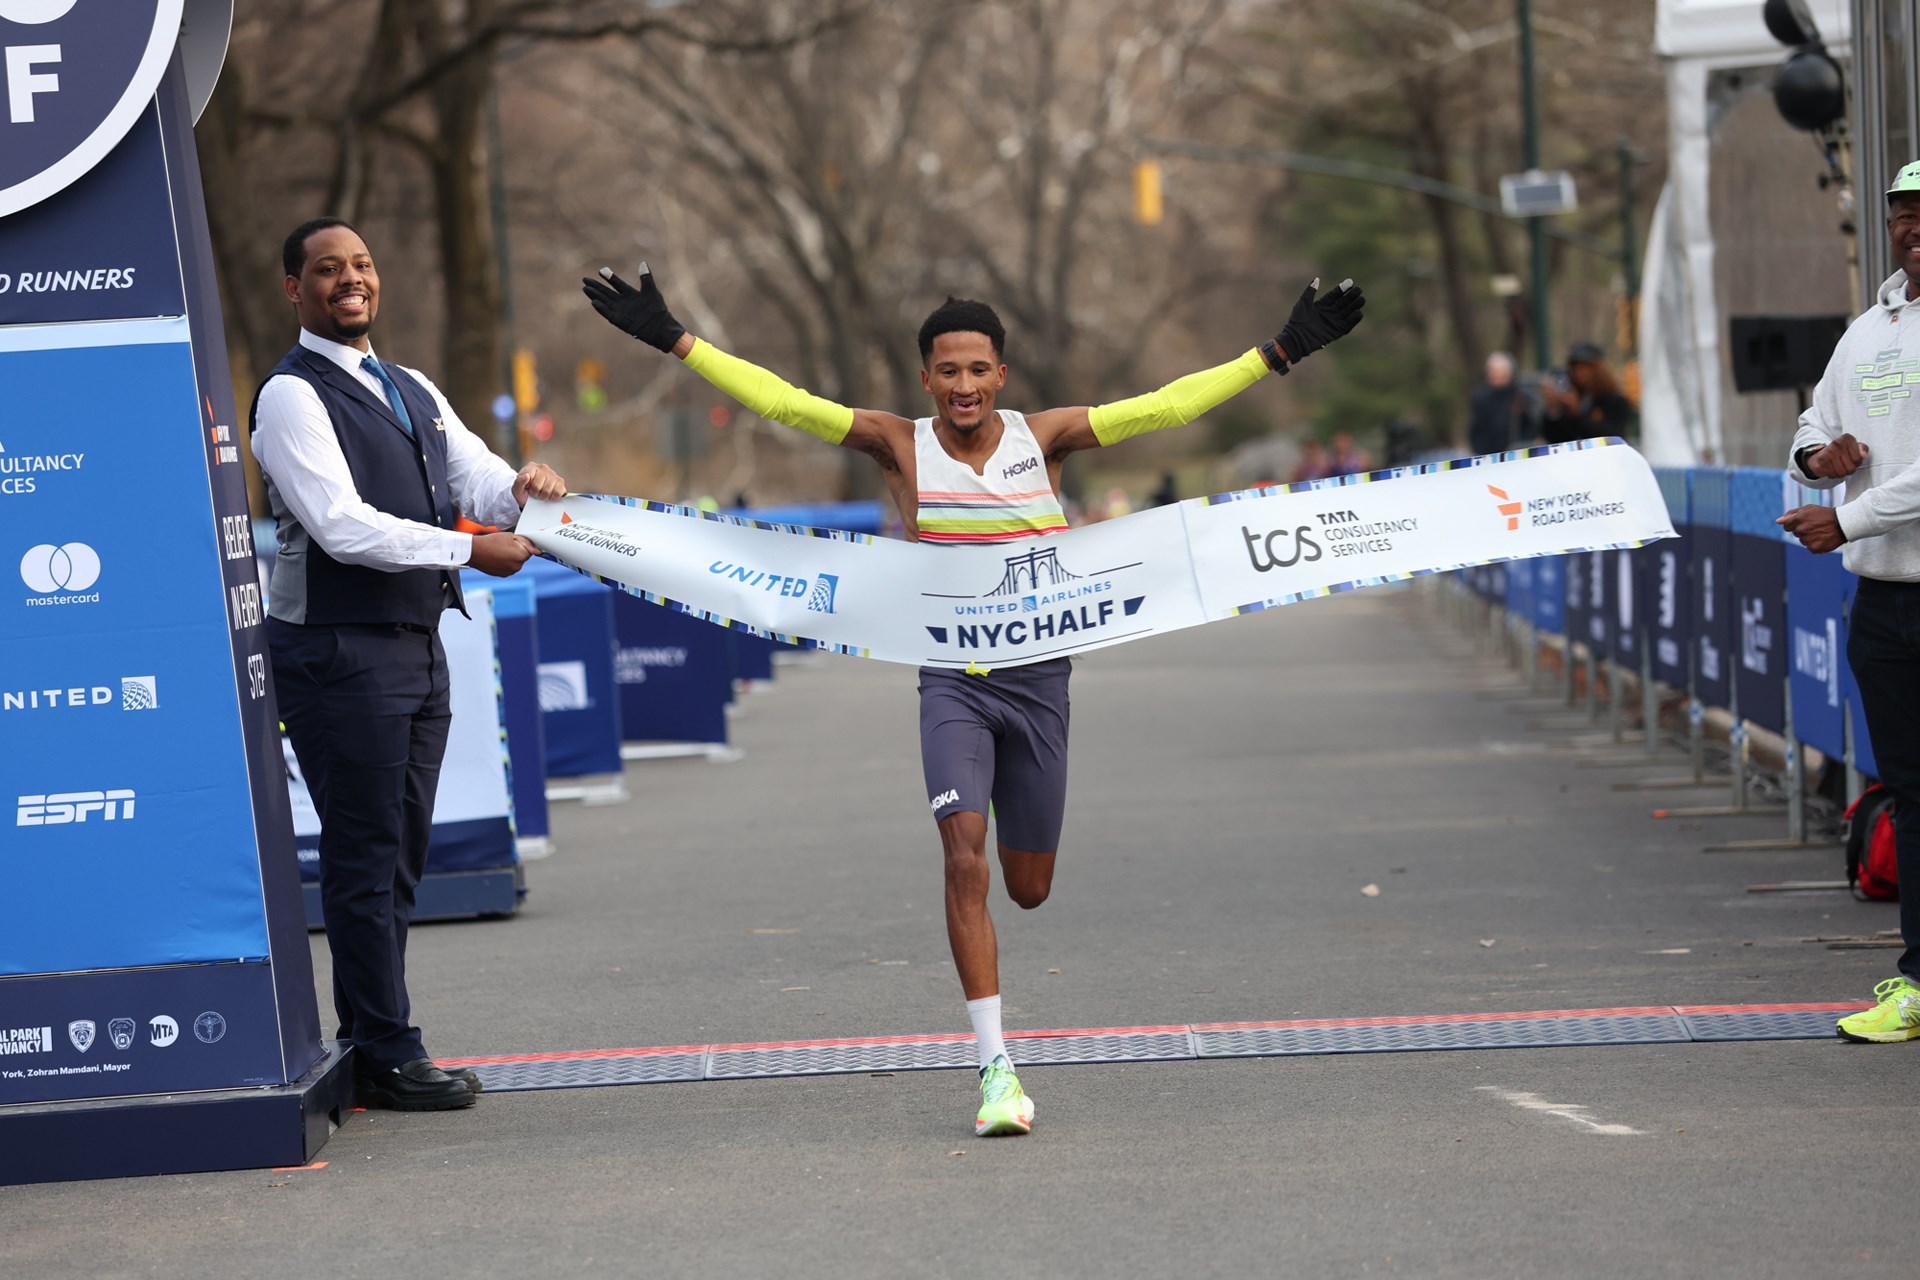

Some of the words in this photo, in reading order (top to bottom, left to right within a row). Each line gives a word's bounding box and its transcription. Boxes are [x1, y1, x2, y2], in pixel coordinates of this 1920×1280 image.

[17, 268, 135, 293] RUNNERS
[1002, 456, 1039, 479] HOKA
[1528, 498, 1555, 512] NEW
[1556, 491, 1592, 507] YORK
[1316, 510, 1359, 525] TATA
[1532, 512, 1566, 527] ROAD
[1569, 502, 1625, 521] RUNNERS
[222, 514, 252, 560] BELIEVE
[1324, 518, 1419, 541] CONSULTANCY
[555, 528, 590, 542] ROAD
[586, 536, 642, 557] RUNNERS
[1242, 526, 1322, 573] tcs
[1330, 538, 1393, 558] SERVICES
[709, 561, 808, 598] UNITED
[26, 592, 99, 606] mastercard
[239, 582, 262, 628] EVERY
[955, 602, 1018, 615] UNITED
[1041, 581, 1112, 605] AIRLINES
[247, 653, 266, 699] STEP
[4, 686, 113, 710] NITED
[16, 789, 136, 826] ESPN
[930, 789, 960, 814] HOKA
[10, 1027, 41, 1041] PARK
[150, 1023, 174, 1041] MTA
[2, 1071, 26, 1079] York,
[27, 1068, 59, 1077] Zohran
[60, 1064, 102, 1076] Mamdani,
[103, 1063, 131, 1072] Mayor
